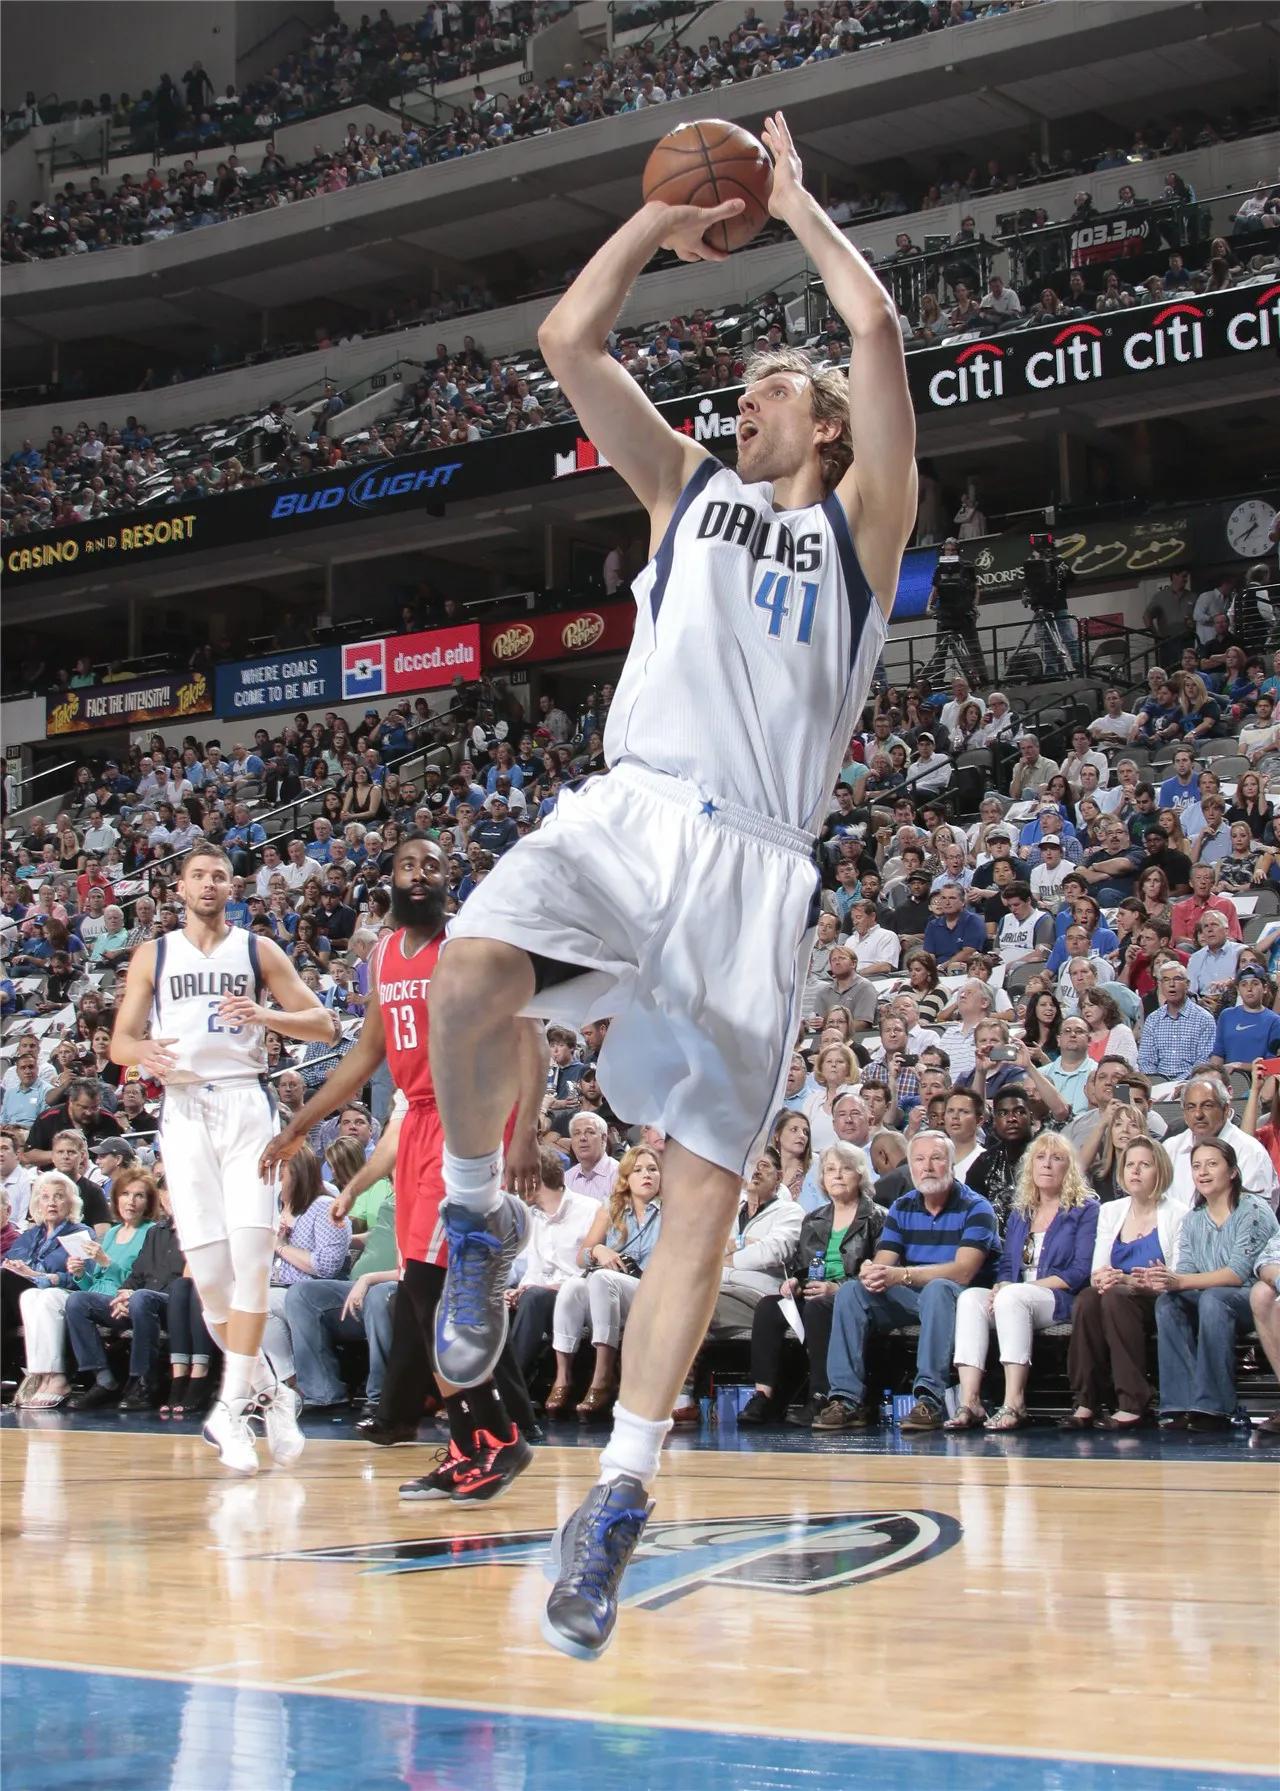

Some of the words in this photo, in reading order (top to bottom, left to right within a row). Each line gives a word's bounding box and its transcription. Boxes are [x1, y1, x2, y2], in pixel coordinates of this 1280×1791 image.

[1123, 312, 1202, 370] citi
[1227, 306, 1280, 351] ci
[928, 354, 1003, 406] citi
[1025, 335, 1102, 389] citi
[695, 411, 740, 441] Ma
[271, 486, 345, 519] BUD
[361, 463, 464, 501] LIGHT
[8, 540, 79, 572] CASINO
[85, 536, 117, 552] AND
[120, 515, 196, 550] RESORT
[975, 566, 1025, 586] NDORF'S
[754, 570, 820, 646] 41
[241, 665, 280, 685] WHERE
[282, 659, 318, 679] GOALS
[394, 643, 474, 673] dcccd.edu
[86, 697, 107, 718] FACE
[108, 694, 124, 714] THE
[124, 686, 170, 711] INTENSITY!!
[233, 688, 267, 707] COME
[267, 686, 283, 702] TO
[285, 683, 301, 700] BE
[302, 679, 326, 697] MET
[170, 972, 248, 1000] DALLAS
[380, 979, 431, 1005] ROCKET
[390, 1005, 418, 1051] 13
